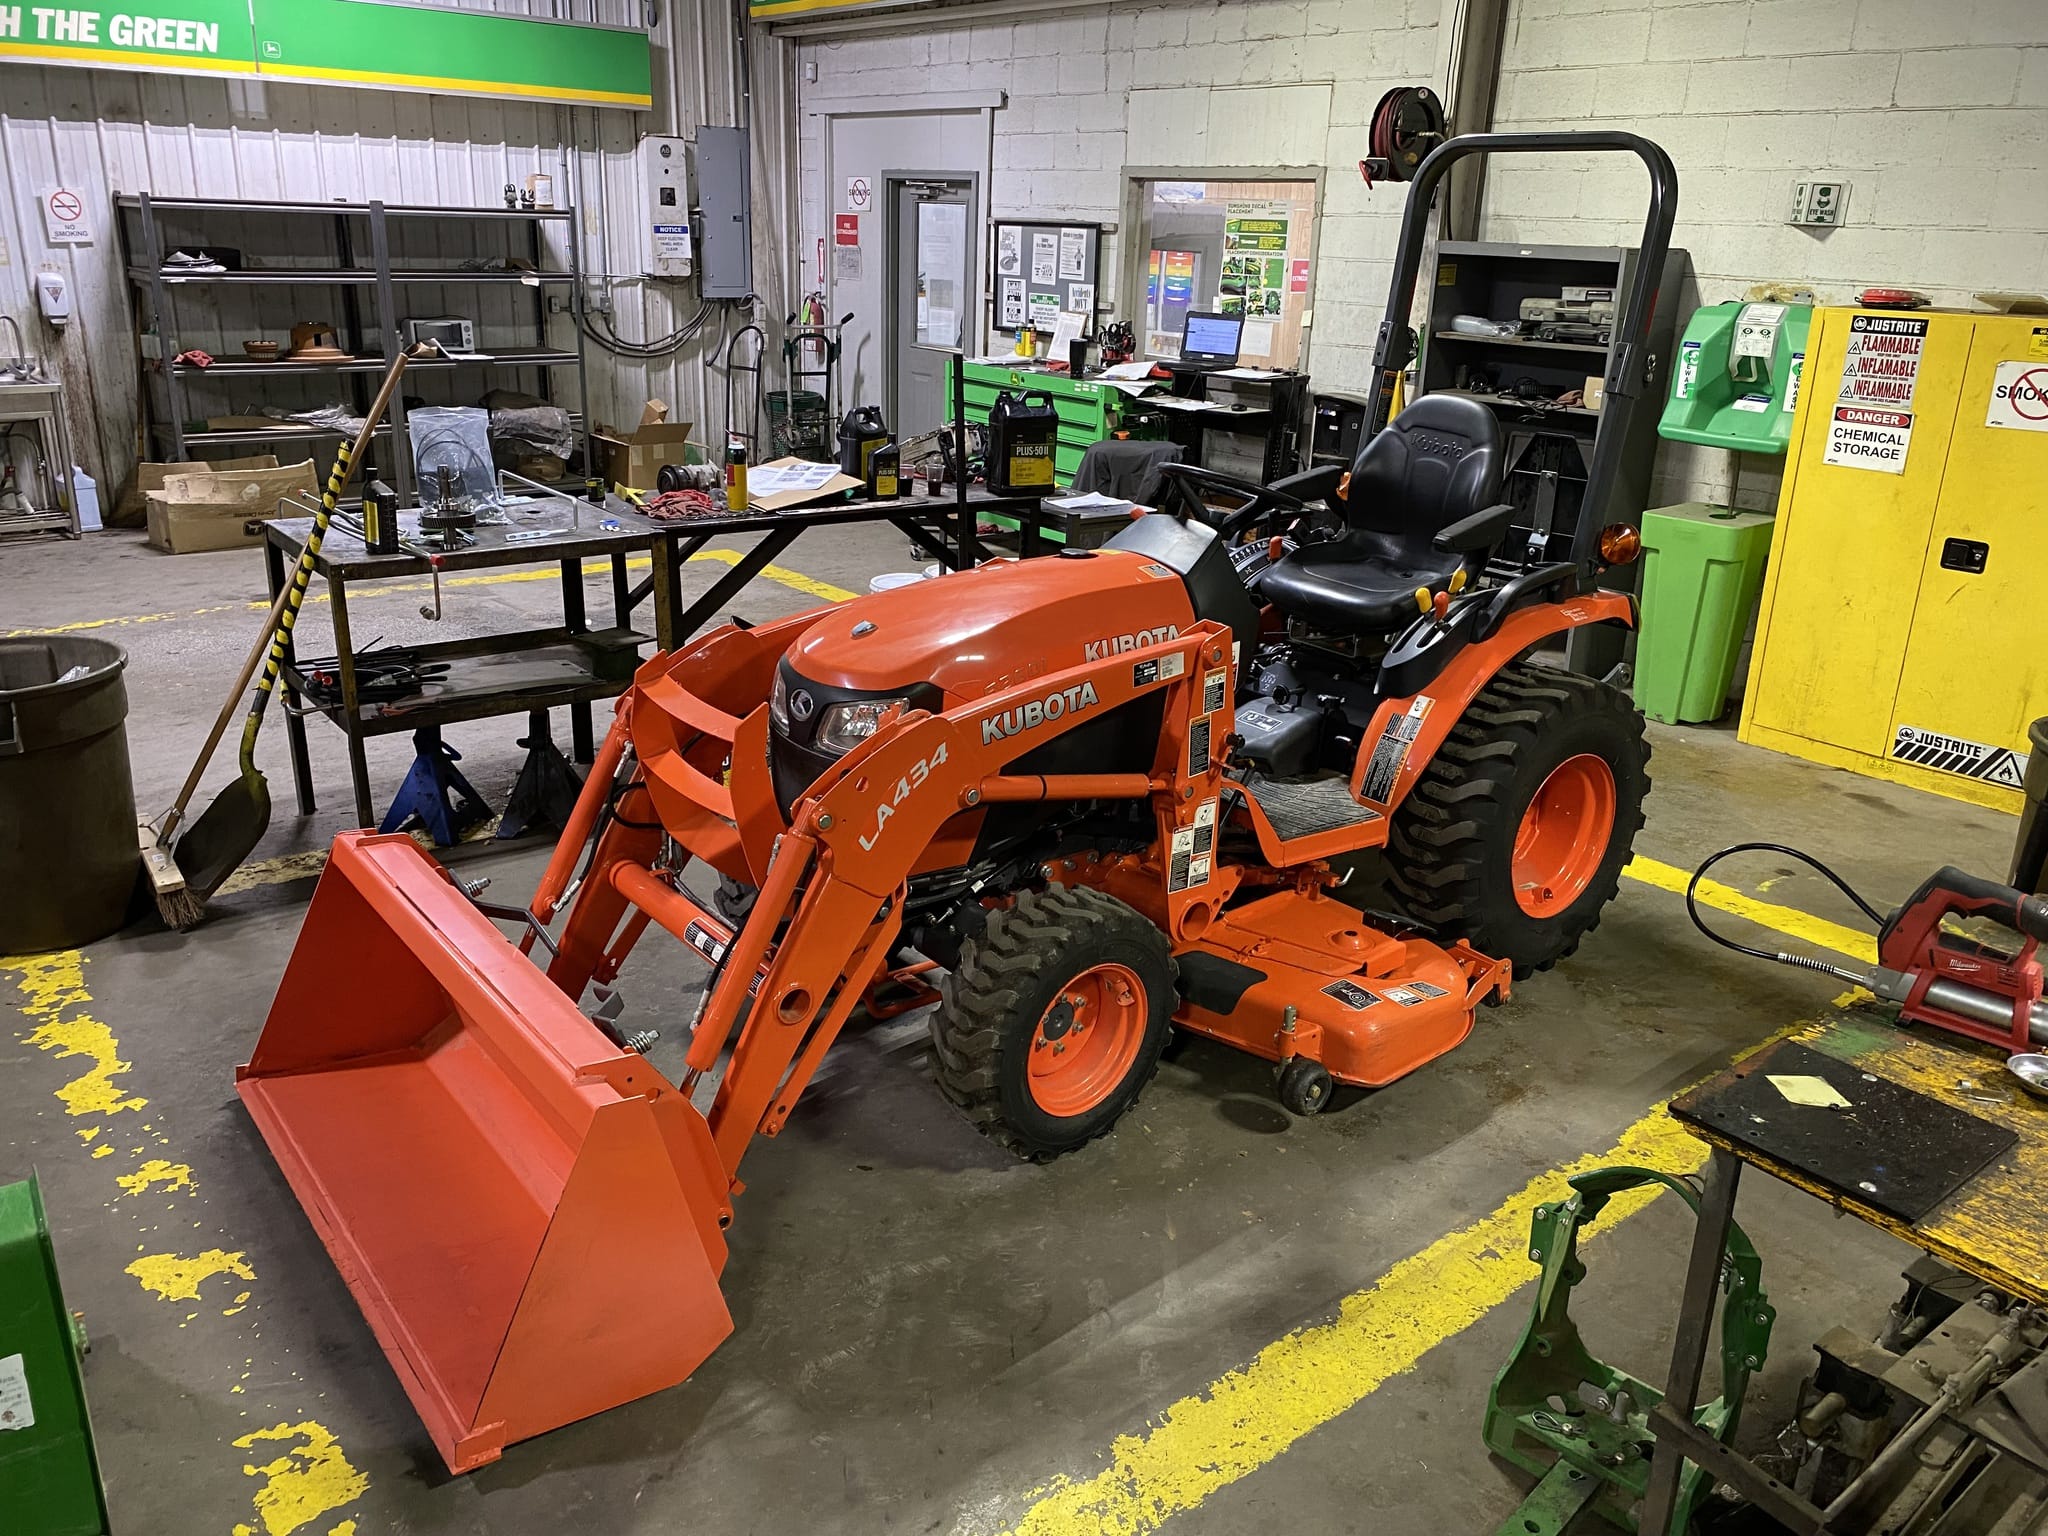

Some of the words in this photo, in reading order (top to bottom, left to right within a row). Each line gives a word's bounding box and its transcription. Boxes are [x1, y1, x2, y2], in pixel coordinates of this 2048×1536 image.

[32, 7, 100, 43] THE
[109, 14, 219, 53] GREEN
[1867, 319, 1922, 334] JUSTRITE
[1861, 335, 1920, 355] FLAMMABLE
[1857, 357, 1916, 378] INFLAMABLE
[1853, 379, 1912, 401] INFLAMMABLE
[1846, 410, 1900, 425] DANGER
[1834, 427, 1905, 446] CHEMICAL
[1016, 446, 1043, 456] PLUS-50
[1833, 442, 1900, 460] STORAGE
[1084, 624, 1181, 663] KUBOTA
[981, 680, 1099, 745] KUBOTA
[1915, 733, 1982, 758] JUSTRITE
[858, 741, 949, 851] LA434
